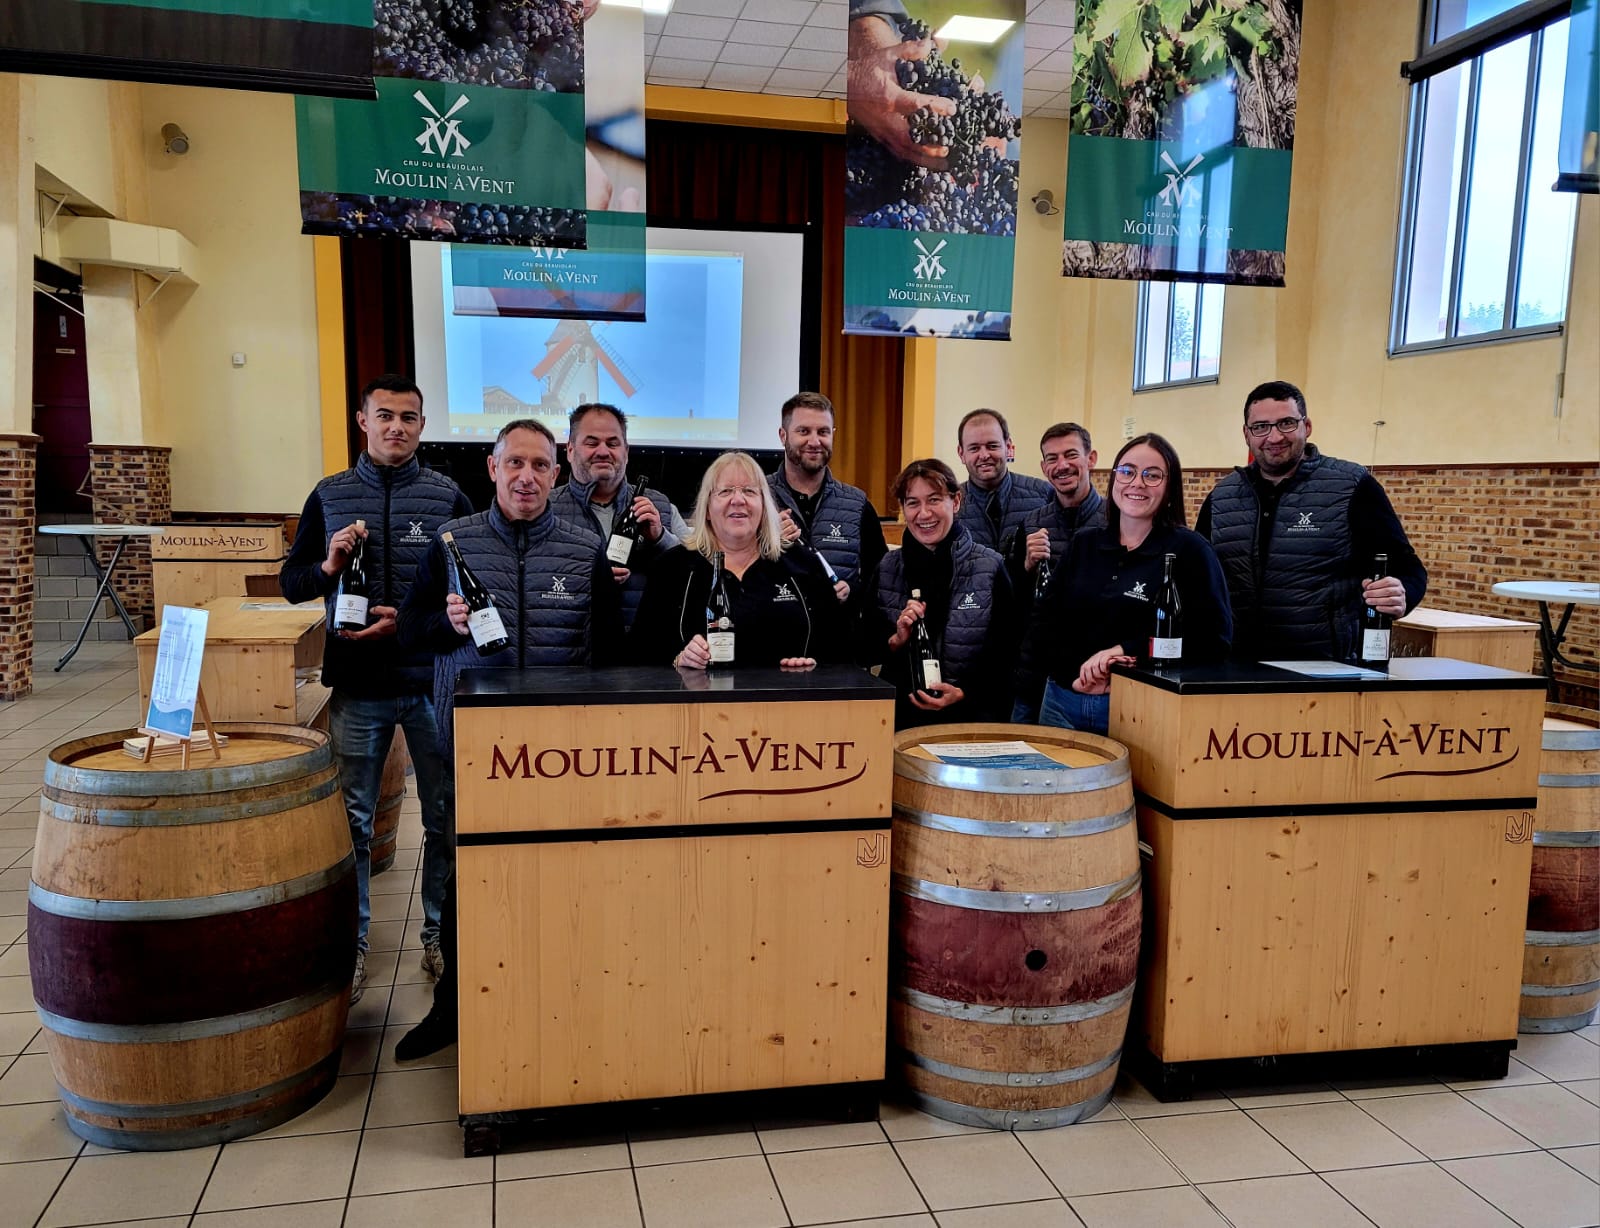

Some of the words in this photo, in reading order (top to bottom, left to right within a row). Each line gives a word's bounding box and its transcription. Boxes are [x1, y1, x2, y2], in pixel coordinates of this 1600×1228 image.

[436, 162, 484, 172] BEAUJOLAIS
[374, 168, 515, 194] MOULIN-À-VENT
[159, 534, 265, 547] MOULIN-À-VENT
[1202, 718, 1511, 760] MOULIN-À-VENT
[486, 731, 856, 780] MOULIN-À-VENT
